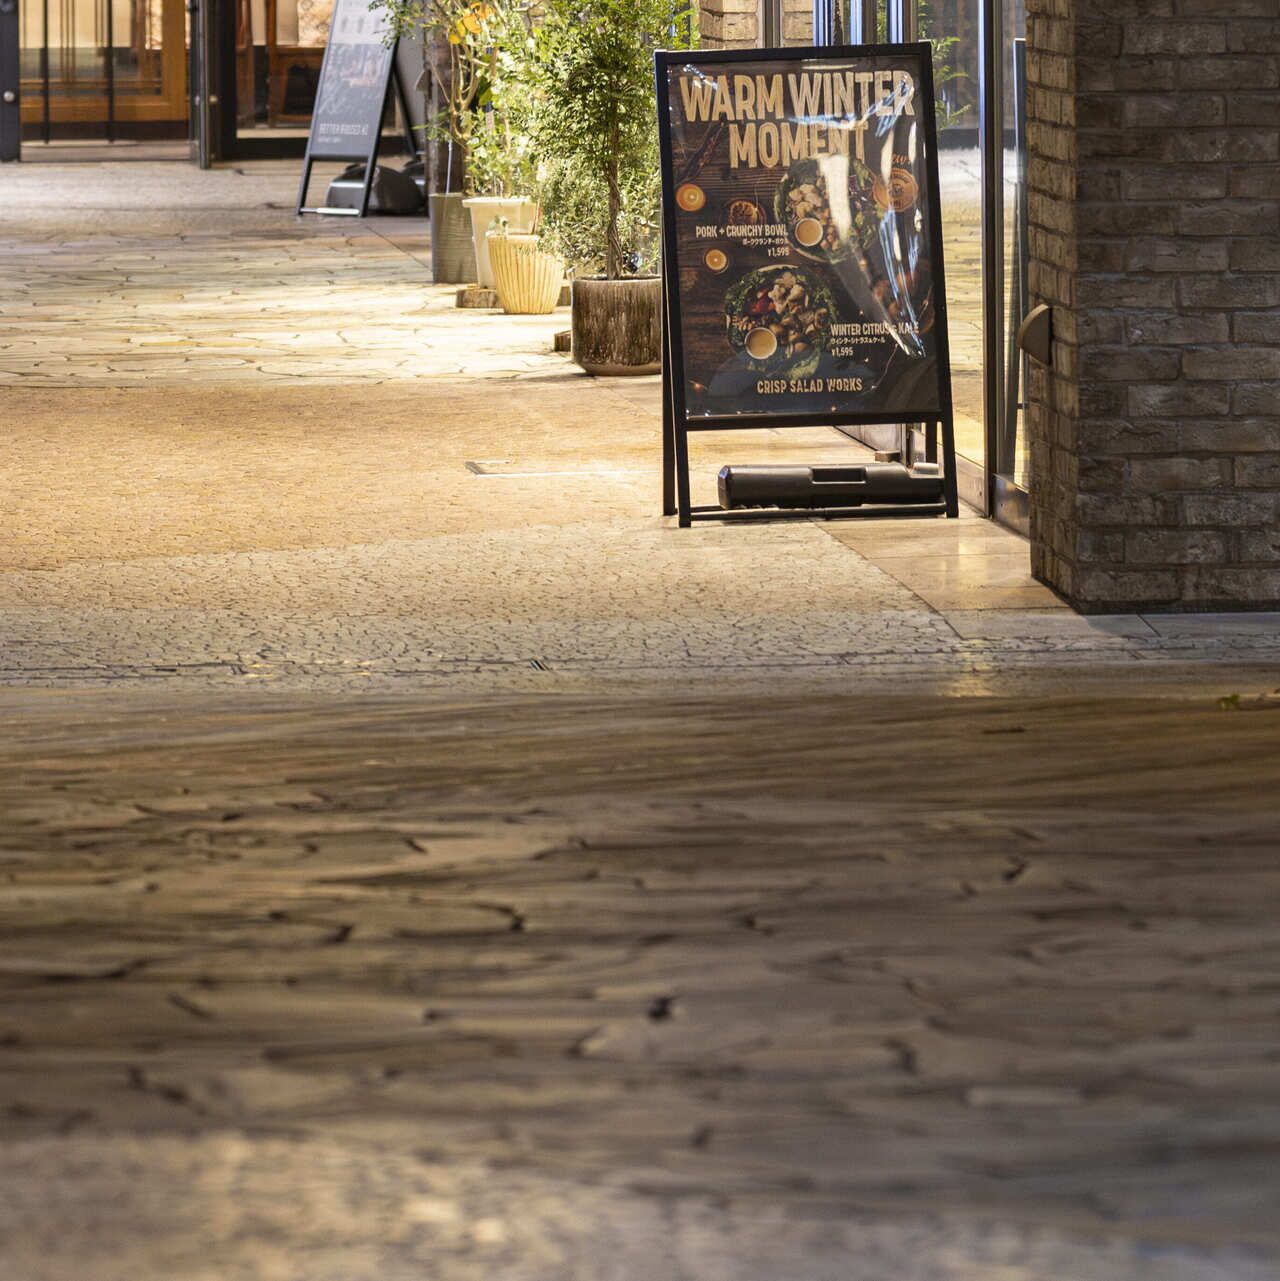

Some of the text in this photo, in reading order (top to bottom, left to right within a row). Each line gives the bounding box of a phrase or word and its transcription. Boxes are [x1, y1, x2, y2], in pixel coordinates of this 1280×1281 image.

[680, 70, 915, 122] WARM WINTER
[729, 122, 868, 169] MOMENT
[696, 226, 717, 238] PORK
[726, 224, 763, 237] CRUNCHY
[765, 224, 788, 236] BOWL
[830, 323, 860, 336] WINTER
[862, 322, 891, 335] CITRUS
[757, 378, 862, 393] CRISP SALAD WORKS
